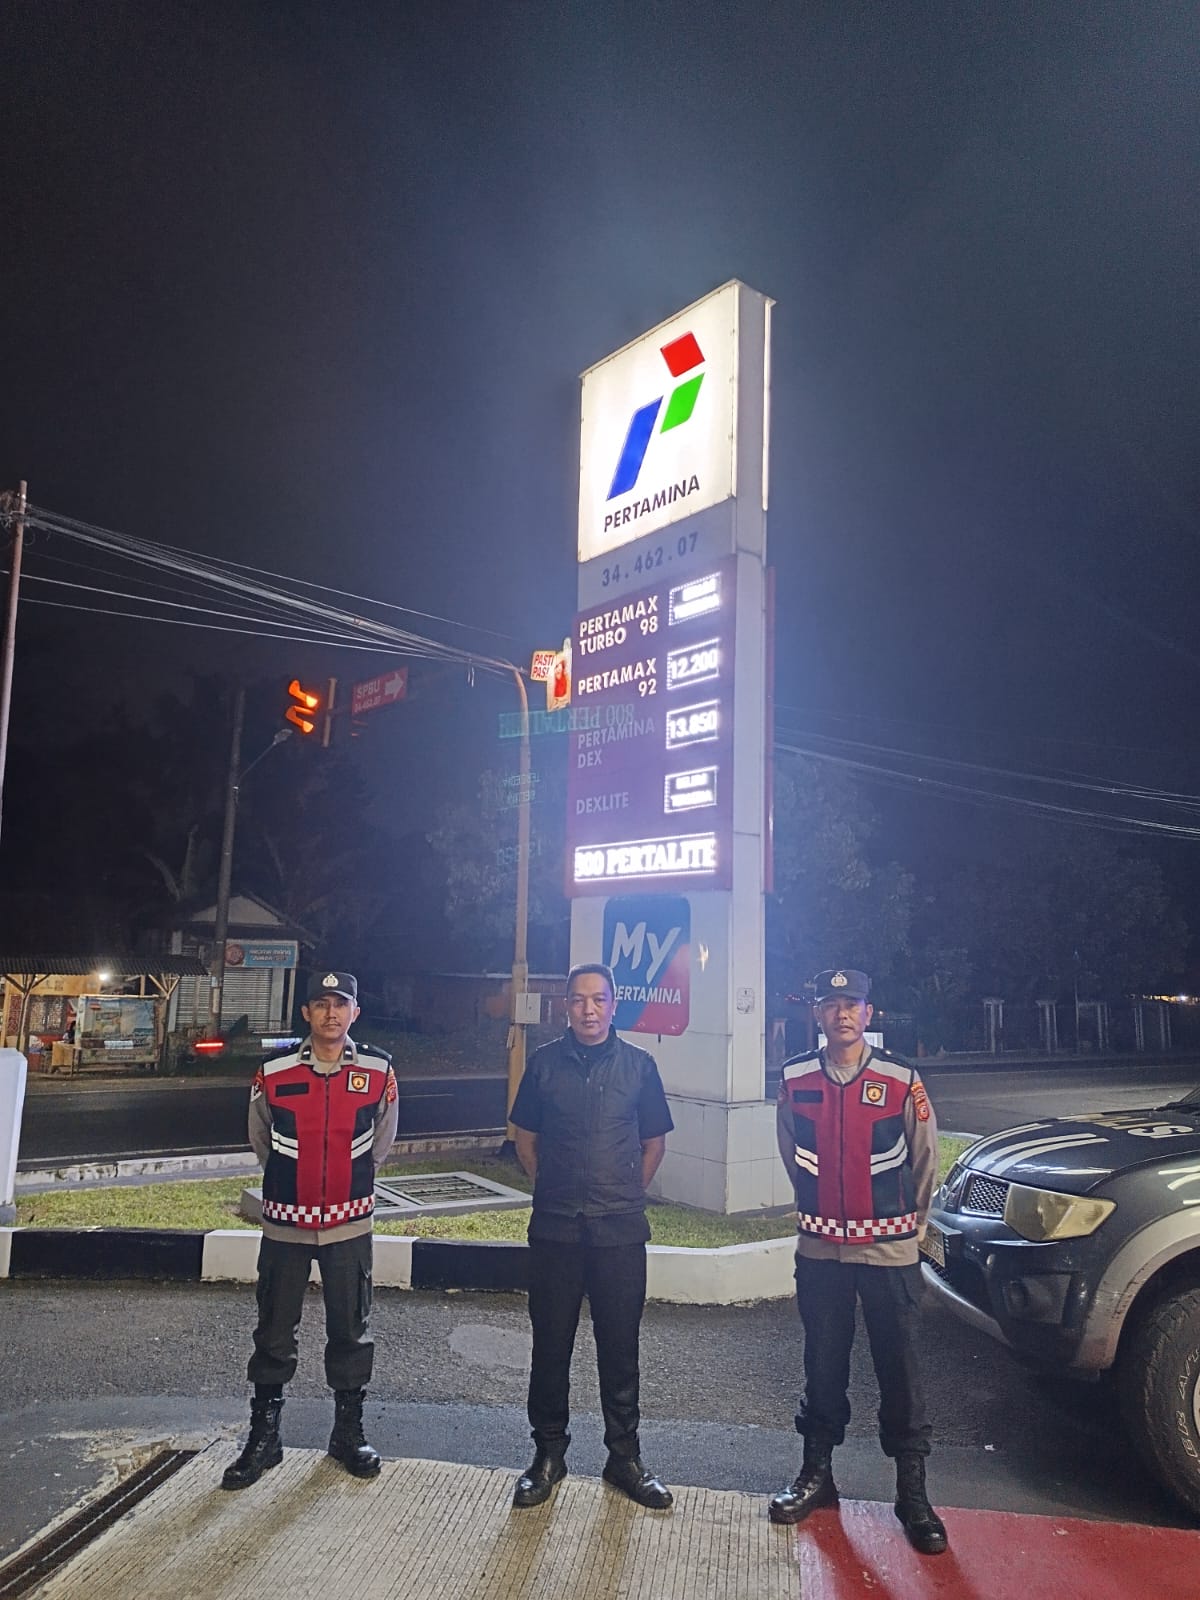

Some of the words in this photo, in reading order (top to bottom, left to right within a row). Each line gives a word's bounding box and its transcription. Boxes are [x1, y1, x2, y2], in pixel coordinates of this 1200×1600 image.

[603, 474, 700, 533] PERTAMINA
[602, 532, 698, 587] 34.462.07
[579, 595, 658, 638] PERTAMAX
[579, 627, 626, 656] TURBO
[640, 615, 659, 636] 98
[534, 654, 554, 667] PASTI
[578, 657, 657, 695] PERTAMAX
[638, 679, 657, 698] 92
[578, 718, 655, 749] PERTAMINA
[577, 749, 602, 769] DEX
[576, 791, 630, 815] DEXLITE
[606, 837, 717, 876] PERTALITE
